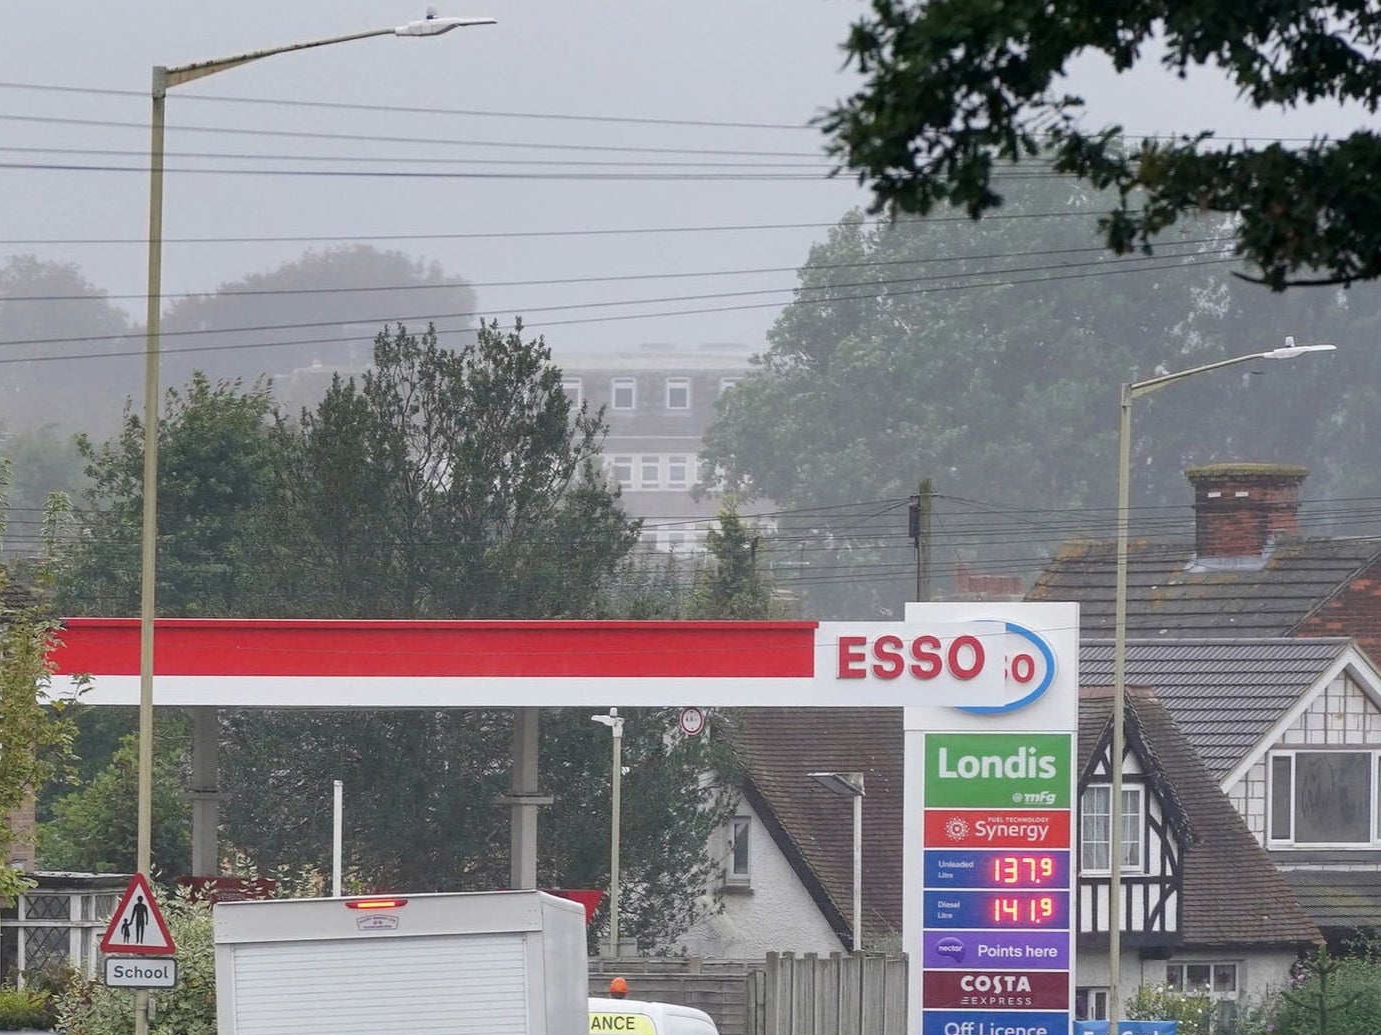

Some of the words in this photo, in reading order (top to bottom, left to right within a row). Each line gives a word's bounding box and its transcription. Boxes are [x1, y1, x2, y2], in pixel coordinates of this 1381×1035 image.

[837, 635, 986, 680] ESSO
[938, 746, 1057, 780] Londis
[975, 821, 1050, 842] Synergy
[937, 860, 975, 869] Unleaded
[937, 901, 961, 909] Diesel
[938, 944, 963, 953] nectar
[977, 944, 1023, 958] Points
[1025, 945, 1059, 958] here
[113, 965, 169, 979] School
[960, 975, 1032, 995] COSTA
[969, 996, 1032, 1006] EXPRESS
[590, 1015, 636, 1030] ANCE
